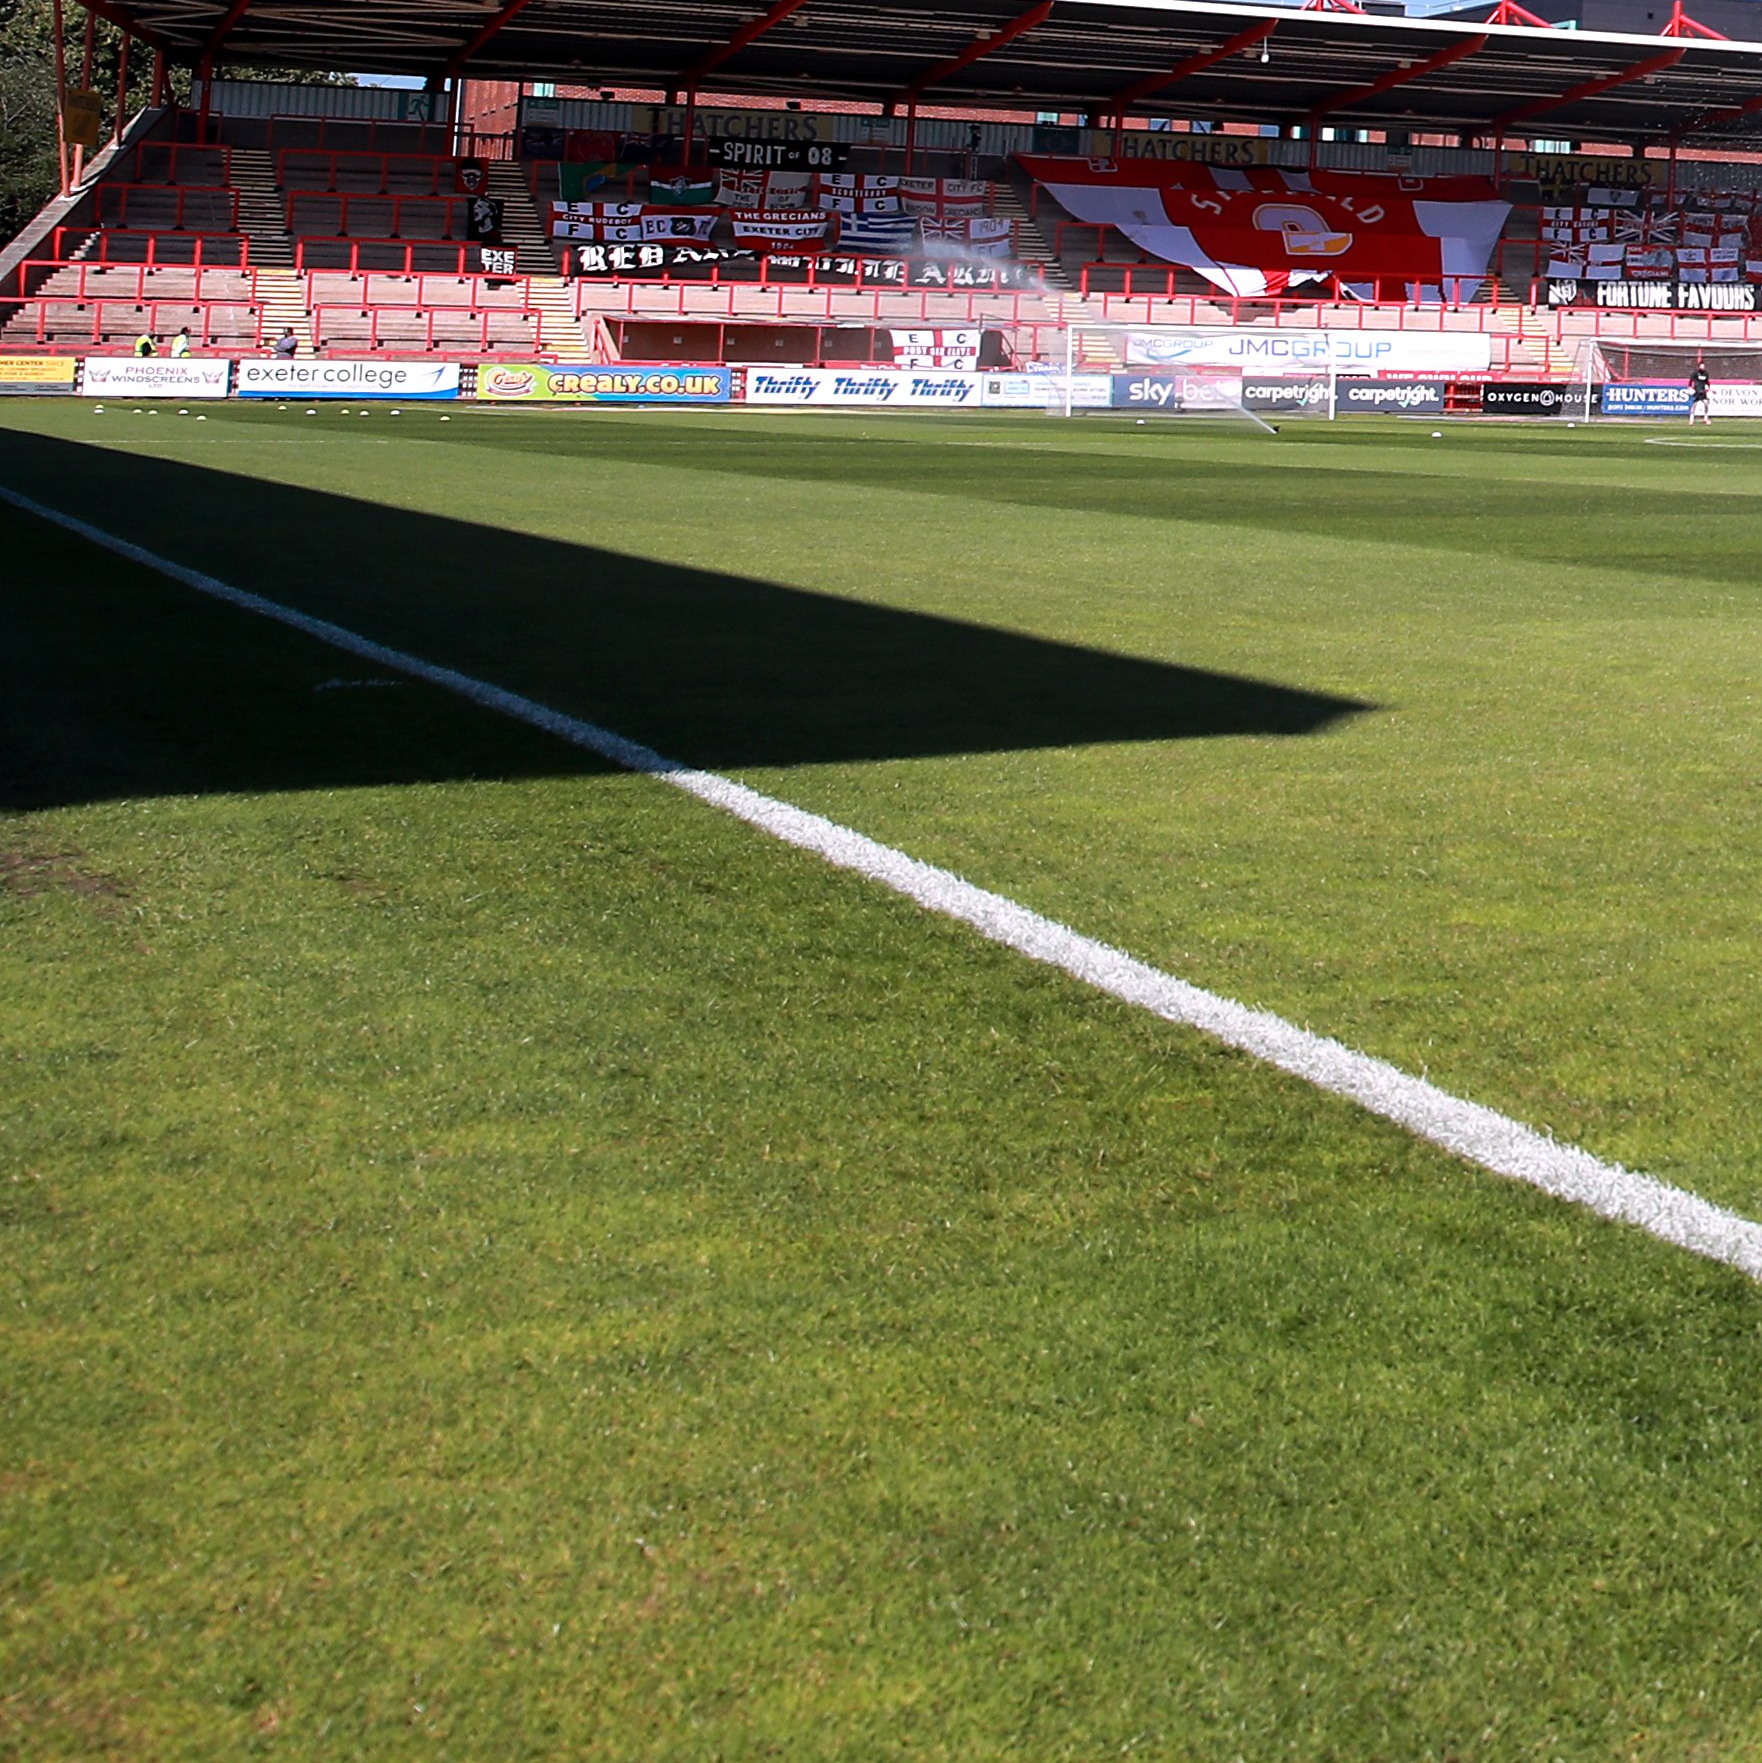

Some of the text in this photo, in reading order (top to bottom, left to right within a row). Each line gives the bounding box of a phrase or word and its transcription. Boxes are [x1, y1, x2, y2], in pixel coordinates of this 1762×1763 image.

[648, 107, 818, 141] THATCHERS
[723, 142, 787, 165] SPIRIT
[808, 147, 832, 165] 08
[1520, 155, 1652, 183] THATCHERS
[832, 175, 887, 187] E C
[567, 201, 629, 215] E C
[832, 199, 886, 210] F C
[562, 214, 585, 222] CITY
[735, 211, 827, 221] THE GRECIANS
[567, 224, 628, 239] F C
[743, 226, 820, 236] EXETER CITY
[480, 248, 516, 264] EXE
[483, 261, 515, 276] TER
[1597, 281, 1673, 308] FORTUNE
[1678, 283, 1755, 310] FAVOURS
[908, 333, 968, 344] E C
[1229, 338, 1392, 359] JMCGROUP
[125, 366, 188, 375] PHOENIX
[909, 358, 919, 369] F
[953, 358, 964, 370] C
[112, 375, 200, 384] WINDSCREENS
[247, 363, 407, 389] exeter college
[754, 375, 821, 400] Thrifty
[833, 377, 899, 401] Thrifty
[910, 378, 975, 403] Thrifty
[1128, 374, 1174, 406] sky
[1245, 381, 1338, 406] carpetrigh.
[1608, 388, 1690, 402] HUNTERS
[1487, 392, 1540, 403] OXYGEN
